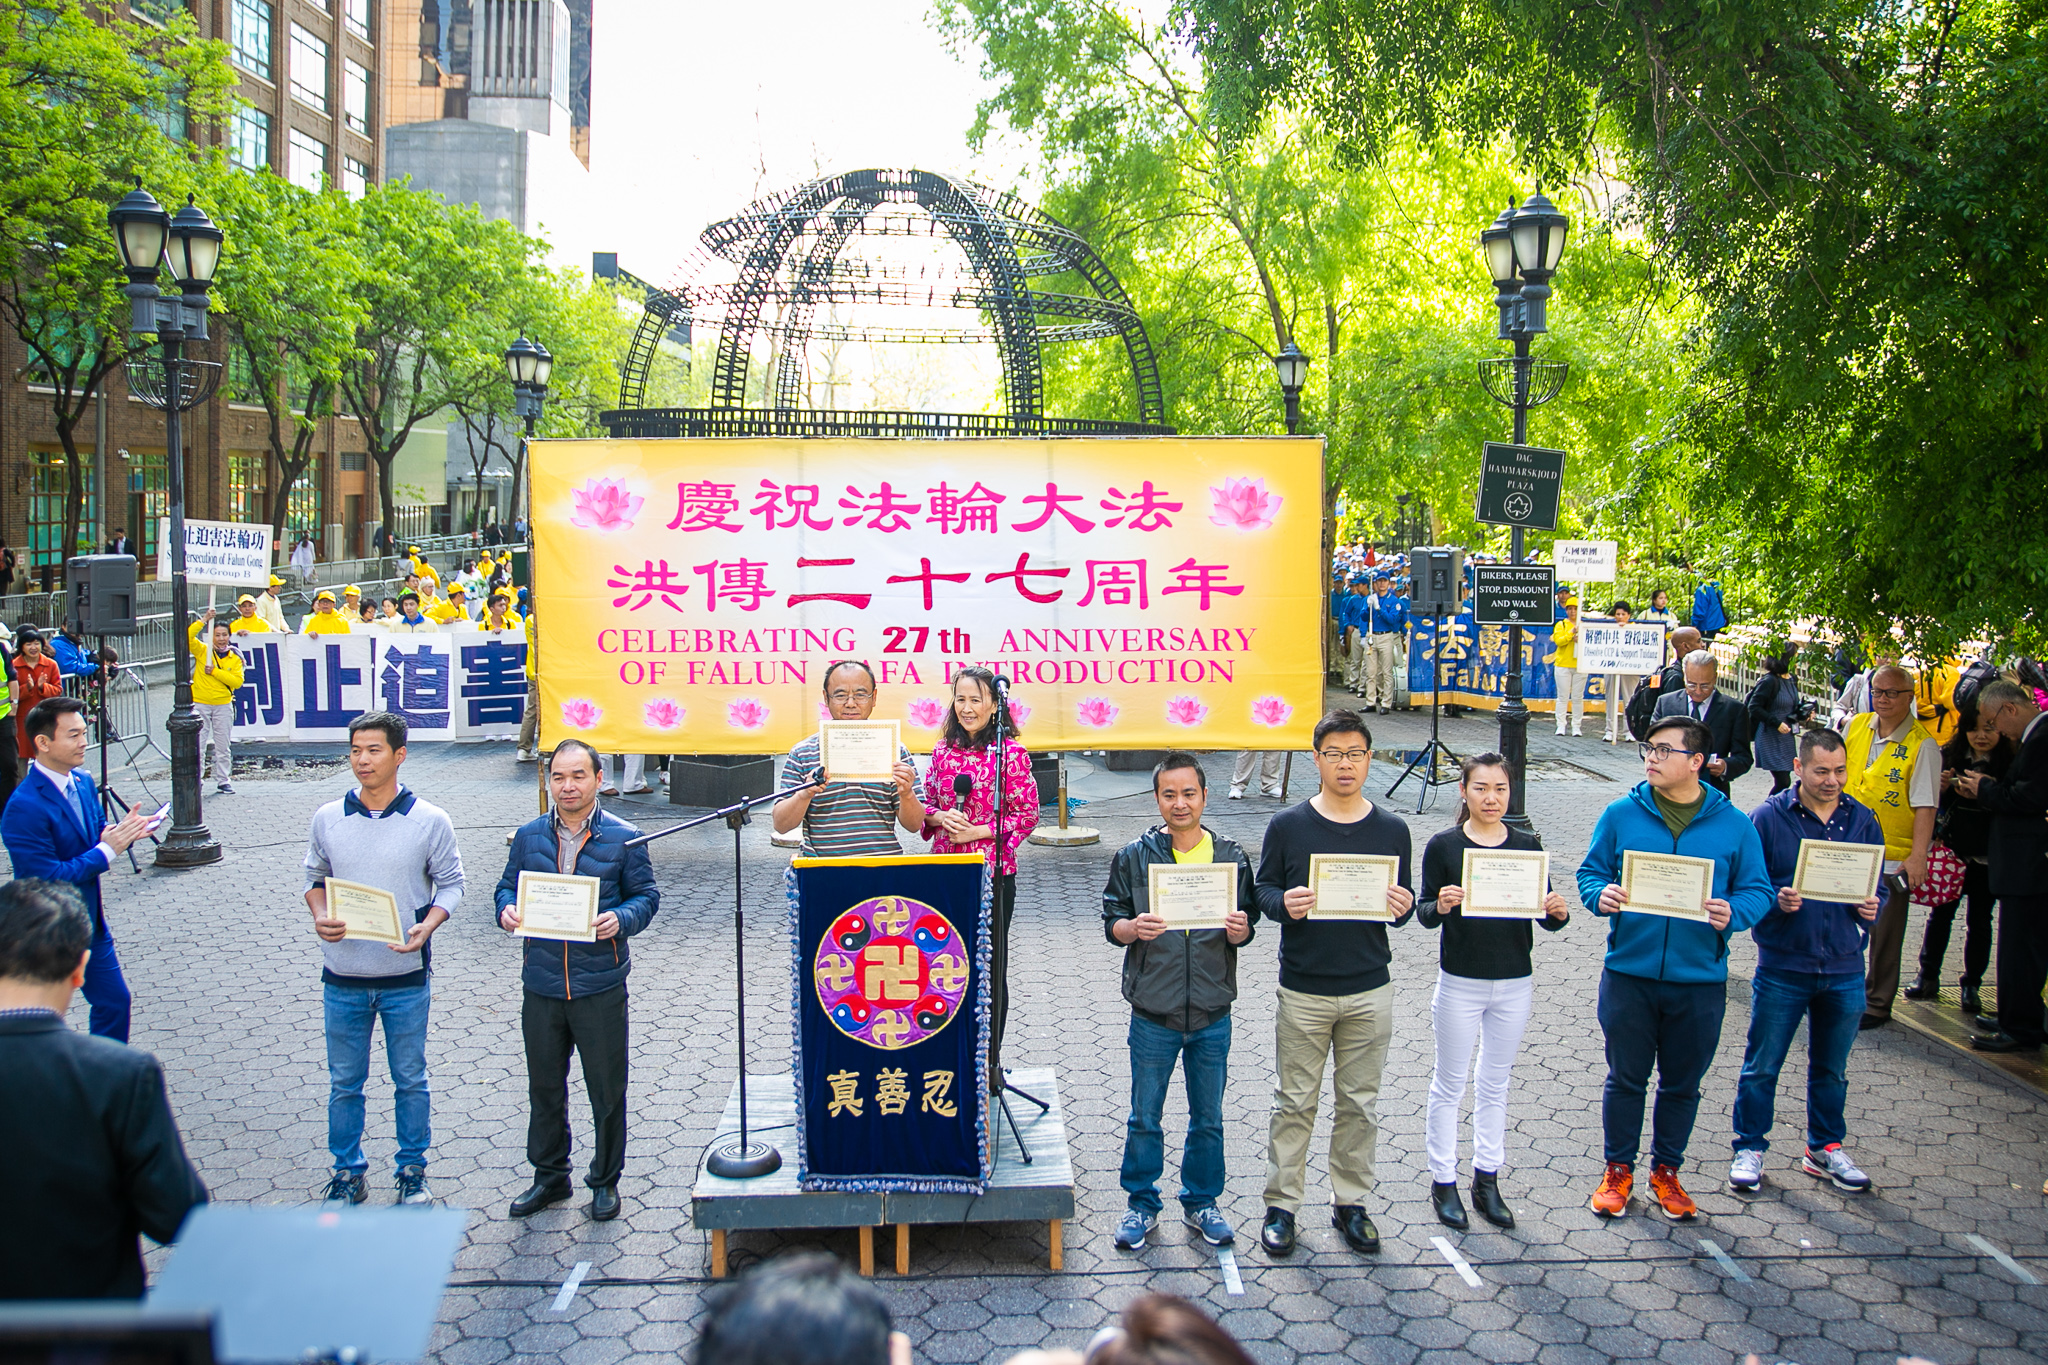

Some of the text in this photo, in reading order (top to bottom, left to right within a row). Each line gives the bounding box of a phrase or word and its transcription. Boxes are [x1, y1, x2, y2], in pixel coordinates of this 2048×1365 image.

[1516, 453, 1533, 463] DAG
[1488, 464, 1558, 480] HAMMARSKJOLD
[1507, 480, 1534, 491] PLAZA
[666, 478, 1183, 533] 慶祝法輪大法
[168, 525, 264, 551] 止迫害法輪功
[219, 553, 225, 565] of
[227, 553, 246, 566] Falun
[246, 554, 264, 569] Gong
[1561, 556, 1586, 565] Tianguo
[1587, 557, 1604, 565] Band
[243, 570, 251, 578] B
[1481, 571, 1549, 581] BIKERS, PLEASE
[607, 552, 1245, 612] 洪傳二十七周年
[1479, 585, 1550, 595] STOP, DISMOUNT
[1491, 599, 1538, 608] AND WALK
[597, 627, 856, 653] CELEBRATING
[998, 627, 1257, 652] ANNIVERSARY
[1604, 647, 1615, 657] CCP
[1620, 648, 1639, 660] Support
[618, 660, 667, 685] OF
[687, 660, 808, 685] FALUN
[828, 659, 924, 685] FA
[827, 1067, 958, 1118] 真善忍
